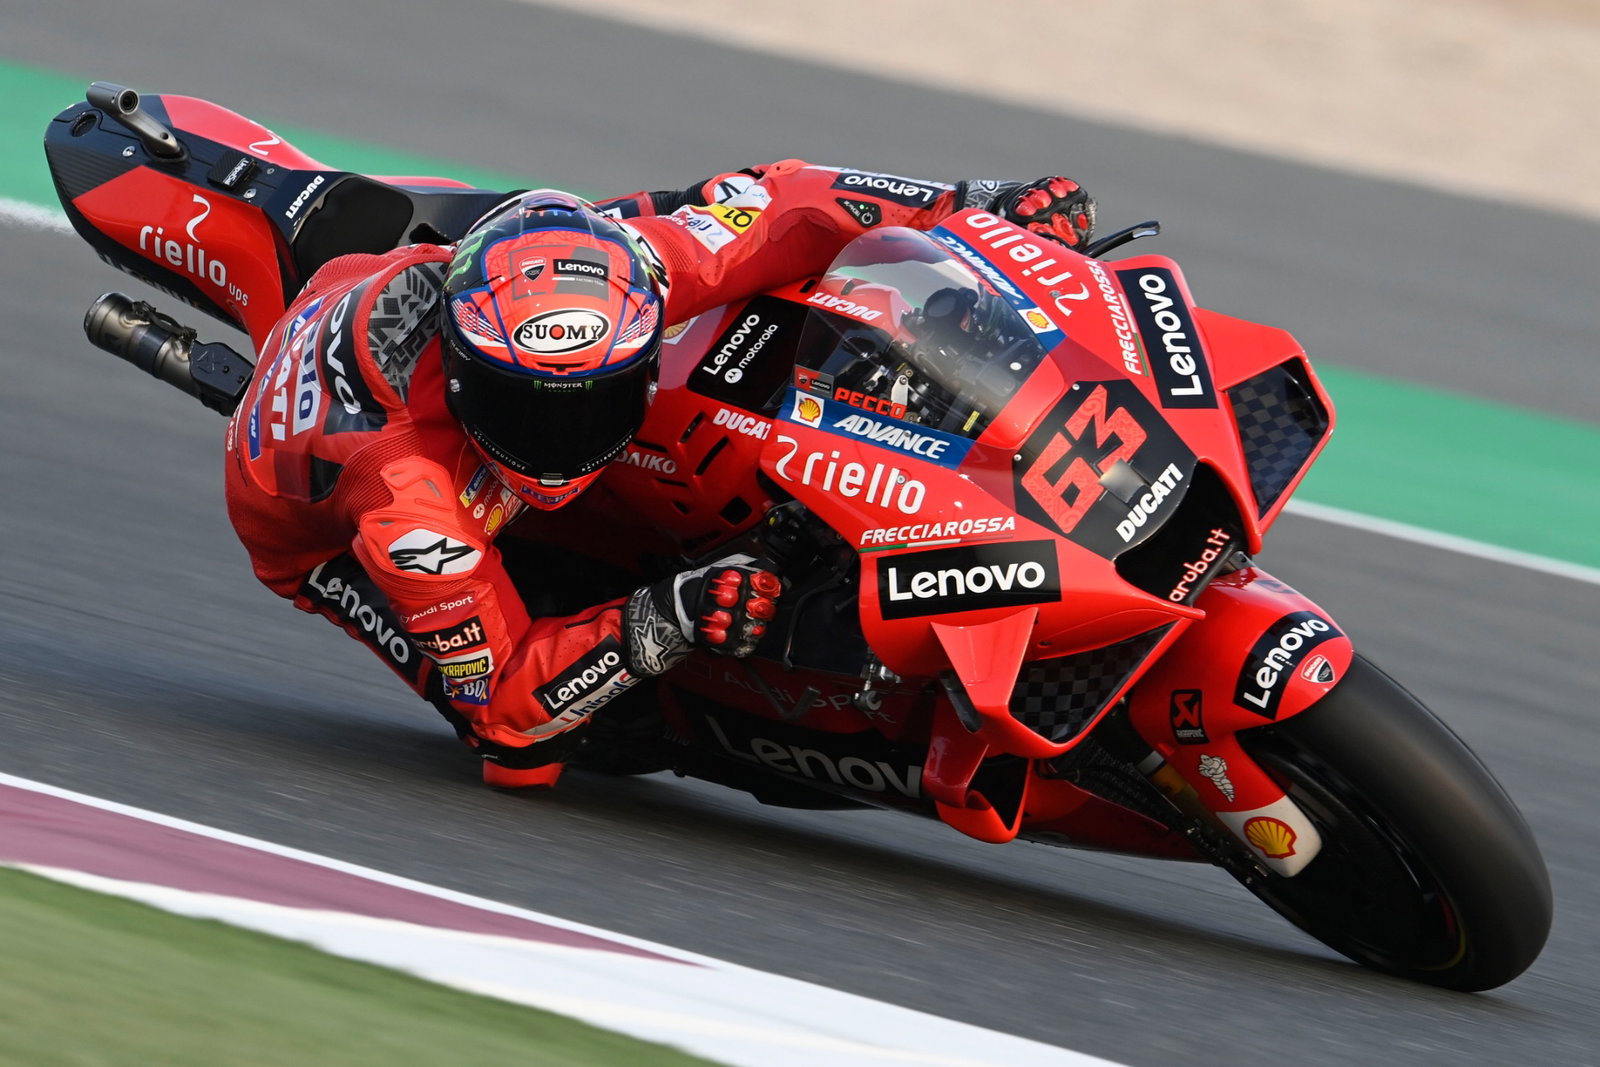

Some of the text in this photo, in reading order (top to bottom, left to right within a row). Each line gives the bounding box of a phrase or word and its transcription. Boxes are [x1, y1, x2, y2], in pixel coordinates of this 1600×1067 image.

[285, 175, 325, 219] DUCATI
[844, 174, 935, 202] Lenovo
[140, 226, 226, 288] riello
[229, 281, 249, 307] ups
[557, 260, 605, 276] Lenovo
[966, 212, 1073, 287] riello
[522, 323, 602, 342] SUOMY
[807, 291, 883, 321] DUCATI
[1085, 260, 1142, 375] FRECCIAROSSA
[703, 314, 760, 375] Lenovo
[739, 323, 779, 370] motorola
[1139, 274, 1204, 396] Lenovo
[543, 381, 583, 389] MONSTER
[833, 386, 908, 420] PECCO
[712, 408, 772, 441] DUCA
[833, 414, 951, 460] ADVANCE
[801, 450, 927, 515] riello
[1020, 383, 1148, 535] 63
[1115, 462, 1185, 543] DUCATI
[860, 516, 1016, 546] FRECCIAROSSA
[888, 561, 1046, 601] Lenovo
[1169, 527, 1231, 602] aruba.it
[307, 561, 410, 664] Lenovo
[410, 595, 474, 623] Audi Sport
[543, 650, 620, 710] Lenovo
[1243, 618, 1330, 709] Lenovo
[704, 713, 923, 799] Lenov
